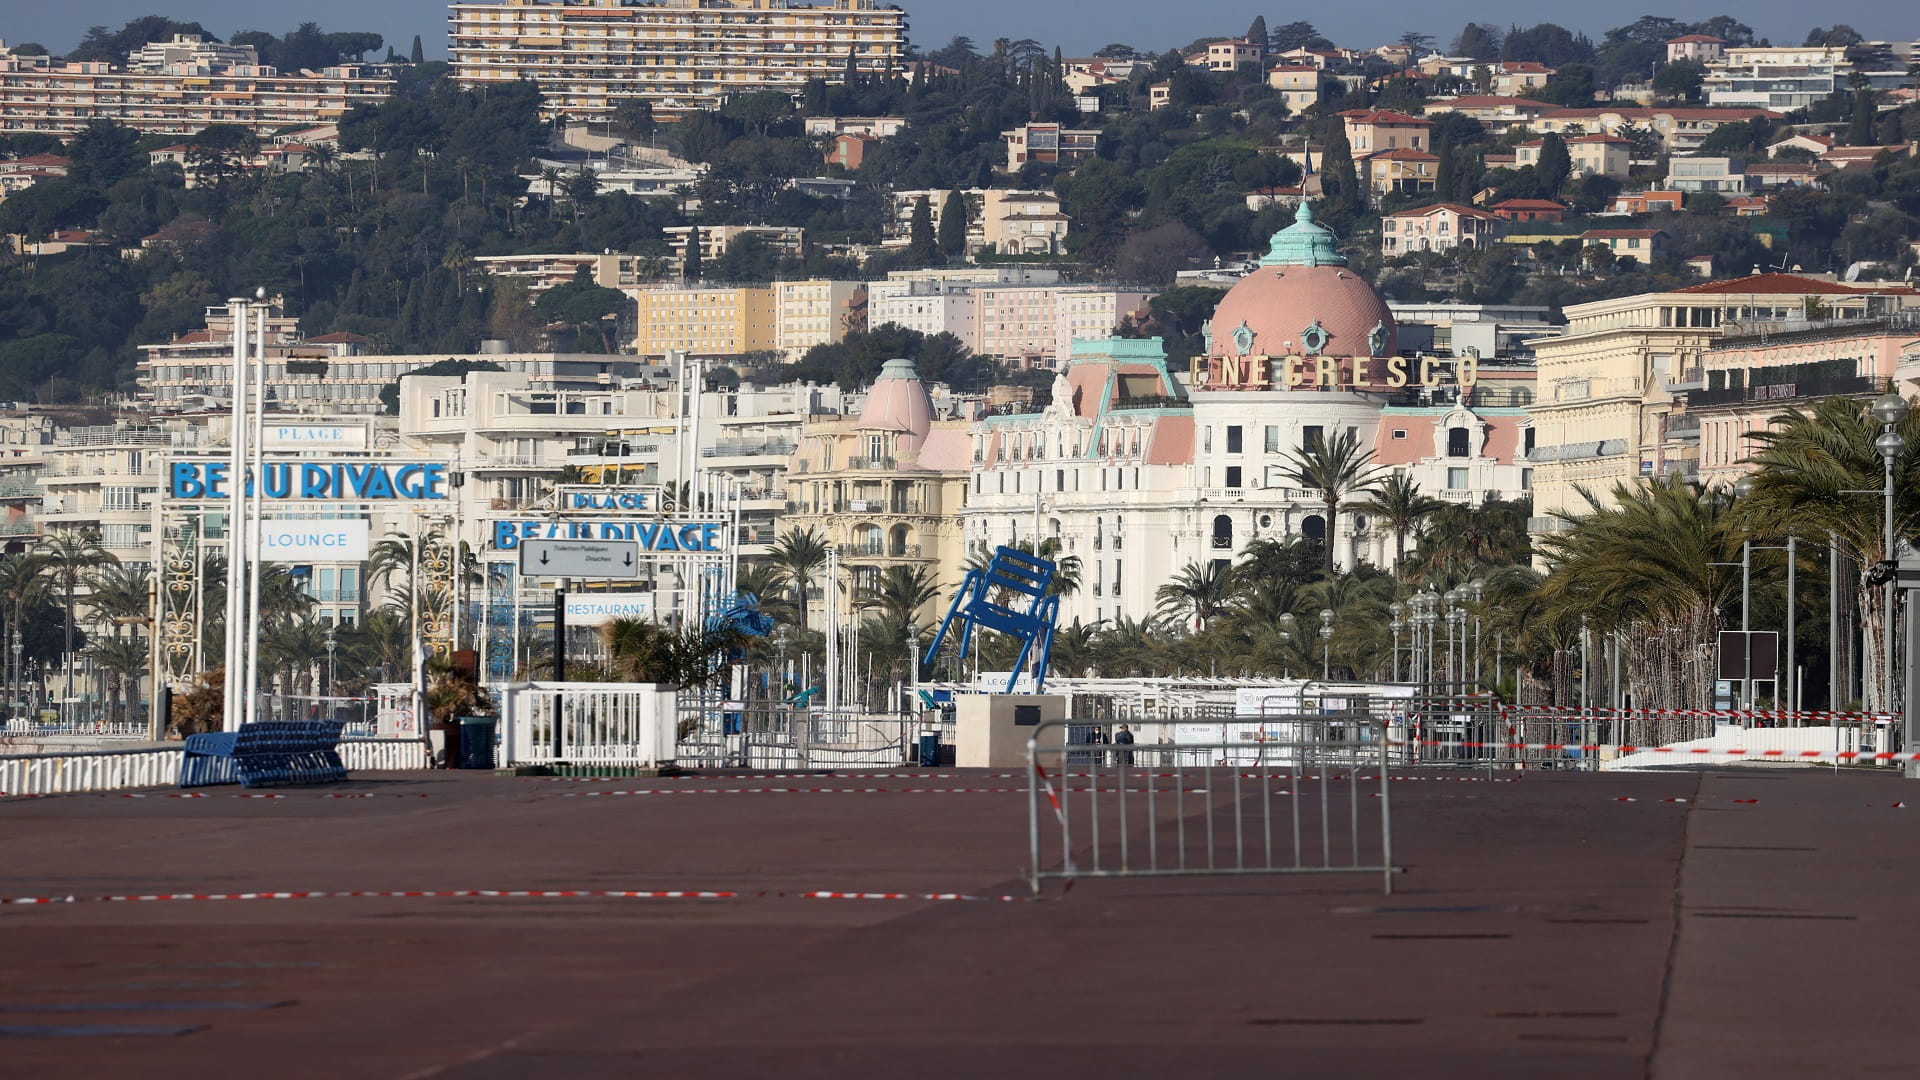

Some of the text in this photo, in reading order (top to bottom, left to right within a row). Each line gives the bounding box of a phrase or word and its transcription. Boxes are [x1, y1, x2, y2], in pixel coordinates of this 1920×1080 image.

[1221, 355, 1478, 387] NEGRESCO
[278, 427, 344, 441] PLAGE
[302, 462, 445, 499] RIVAGE
[573, 494, 646, 509] PLAGE
[268, 533, 347, 547] LOUNGE
[567, 604, 647, 615] RESTAURANT
